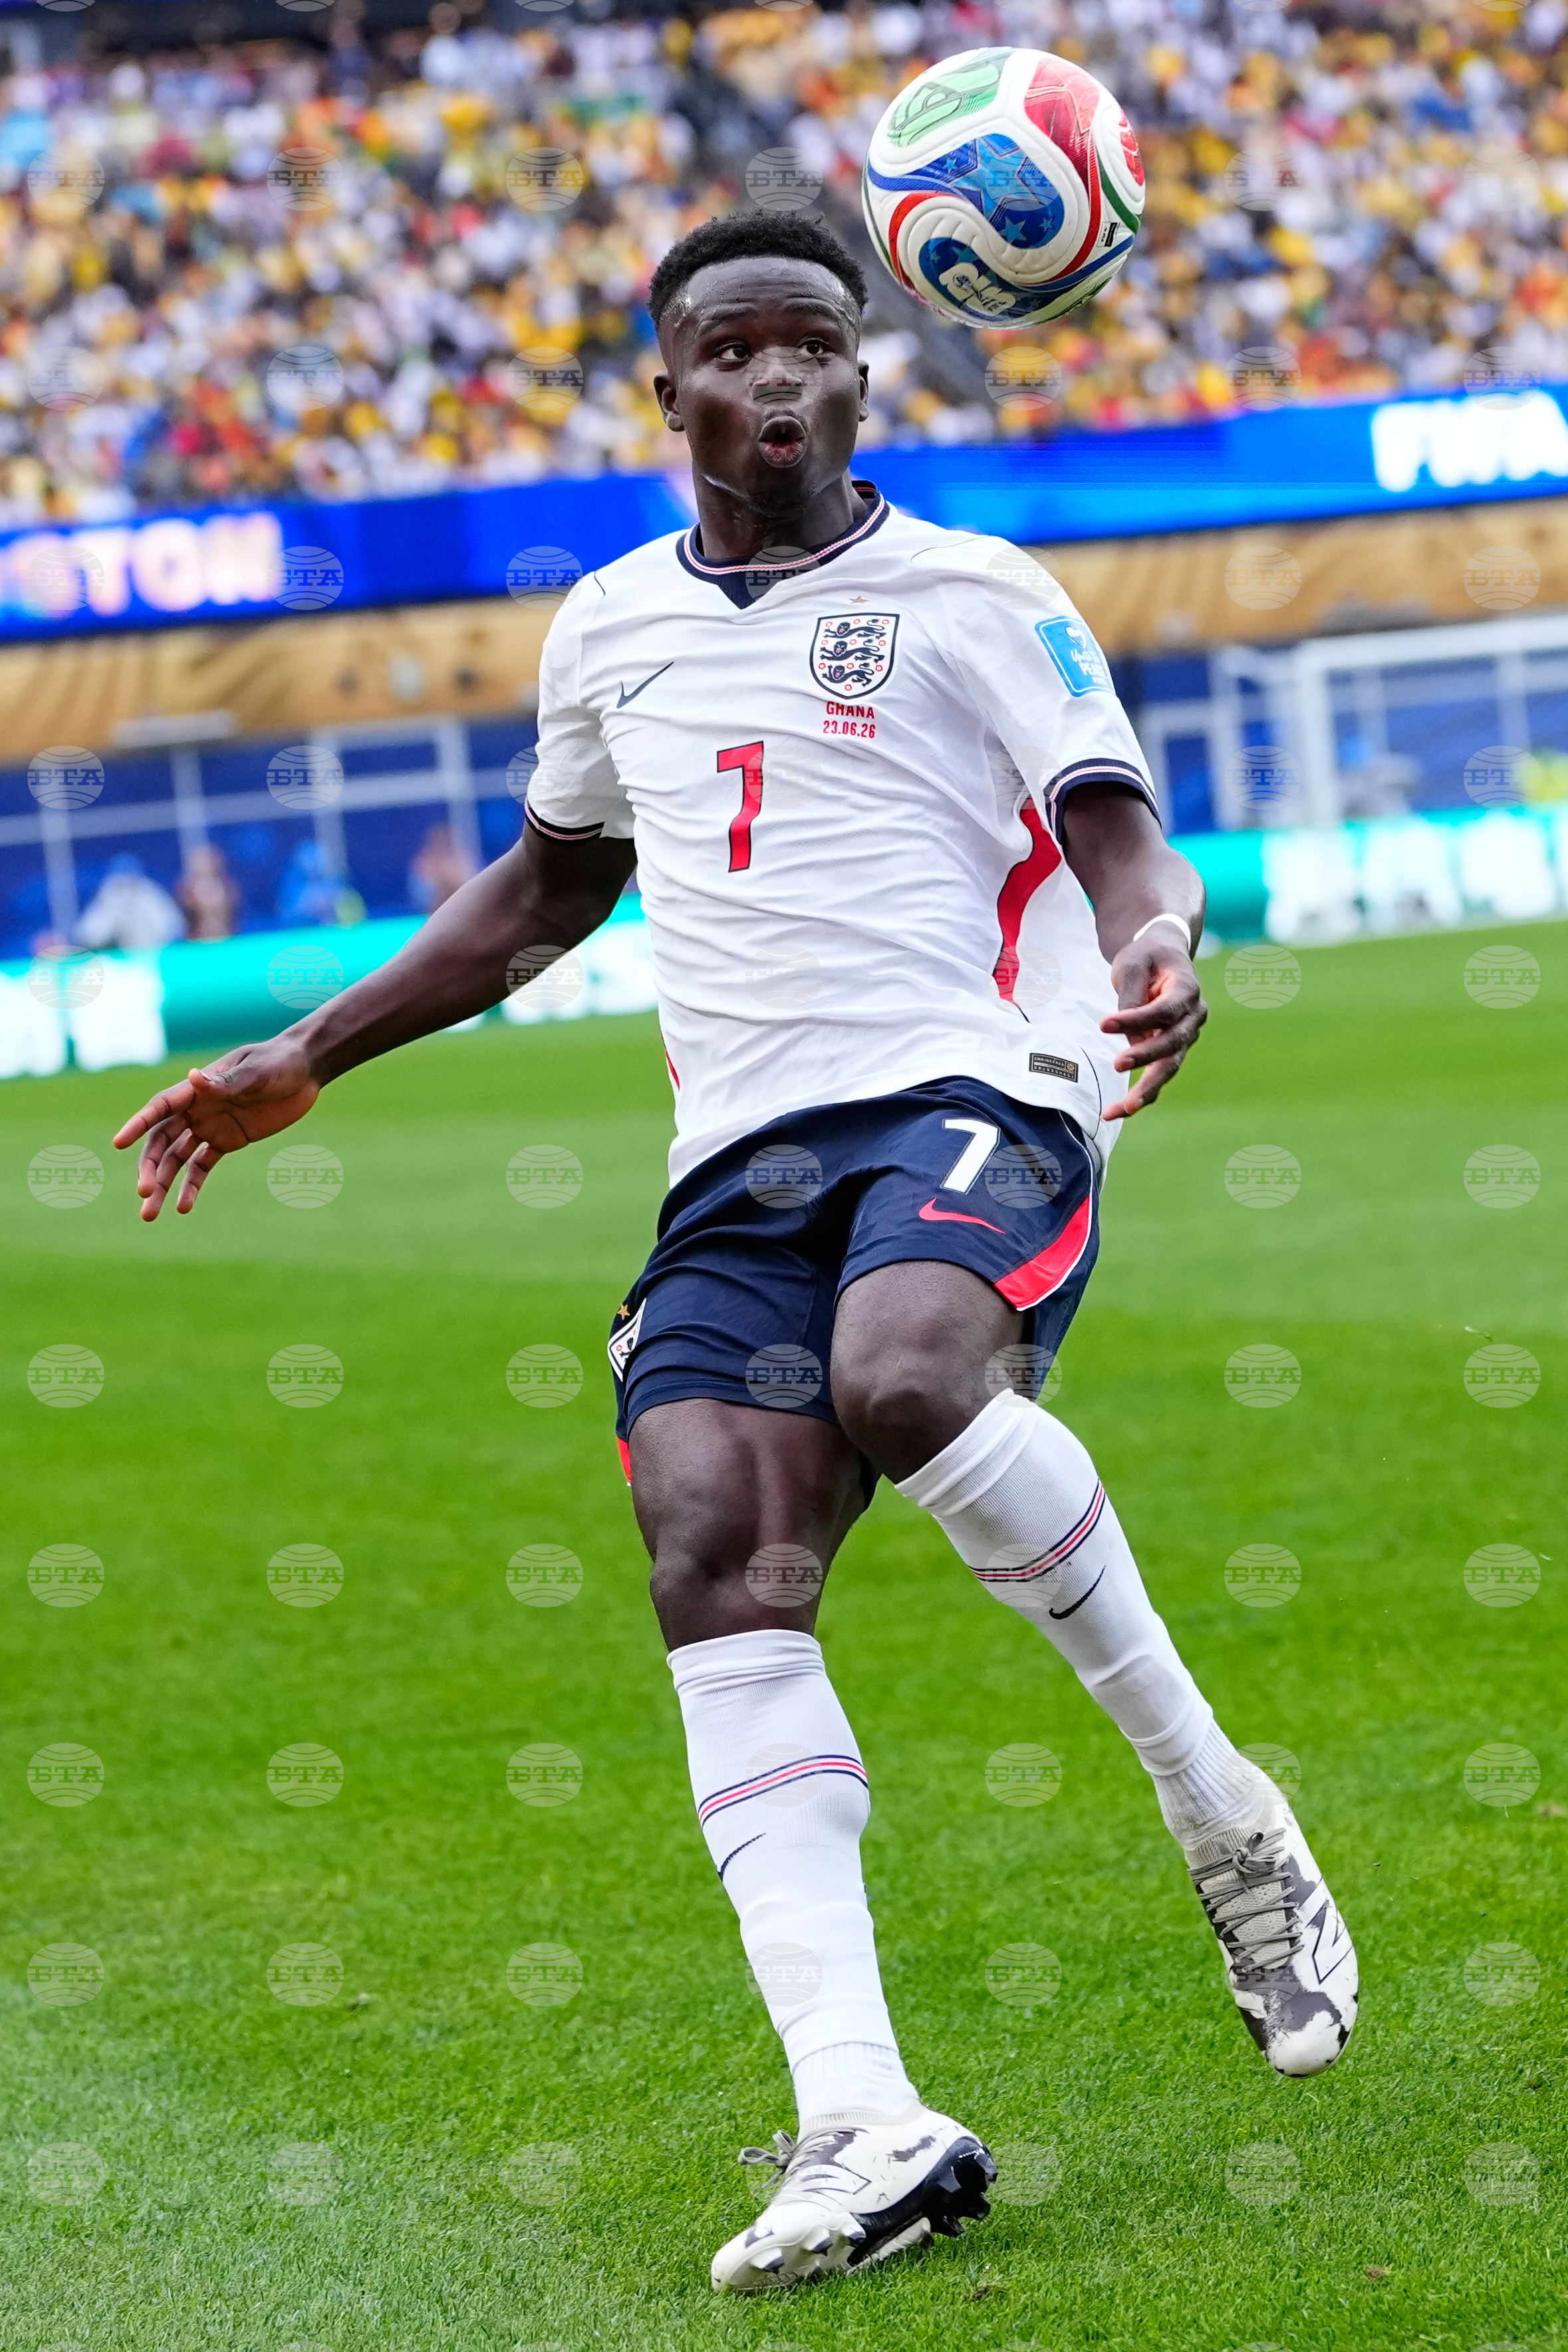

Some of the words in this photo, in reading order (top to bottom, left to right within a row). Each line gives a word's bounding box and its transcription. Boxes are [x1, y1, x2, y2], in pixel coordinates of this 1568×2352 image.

[823, 720, 876, 738] 23.06.26
[826, 702, 875, 719] GHANA
[717, 740, 764, 872] 7
[940, 1118, 1001, 1196] 7
